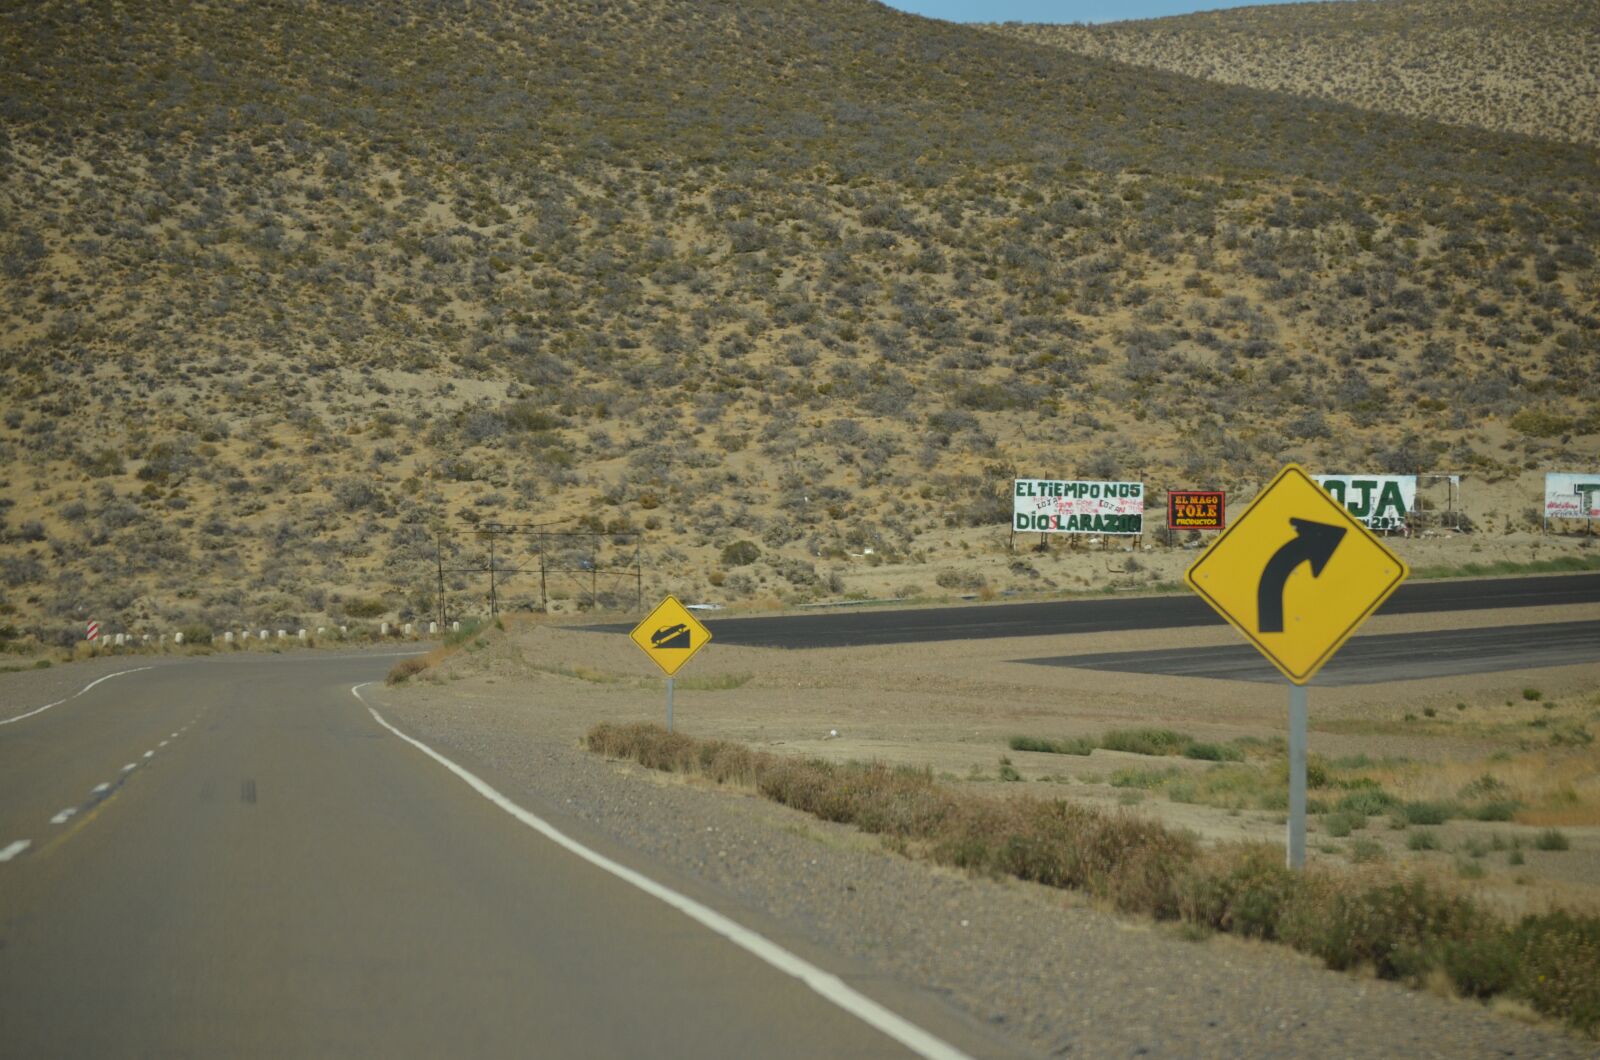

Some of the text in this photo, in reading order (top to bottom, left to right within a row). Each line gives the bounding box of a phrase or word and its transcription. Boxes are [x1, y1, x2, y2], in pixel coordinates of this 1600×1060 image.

[1016, 482, 1036, 496] EL
[1104, 484, 1141, 498] NOS
[1175, 495, 1218, 504] EL MAGO
[1312, 479, 1408, 517] OJA
[1175, 504, 1217, 517] TOLE
